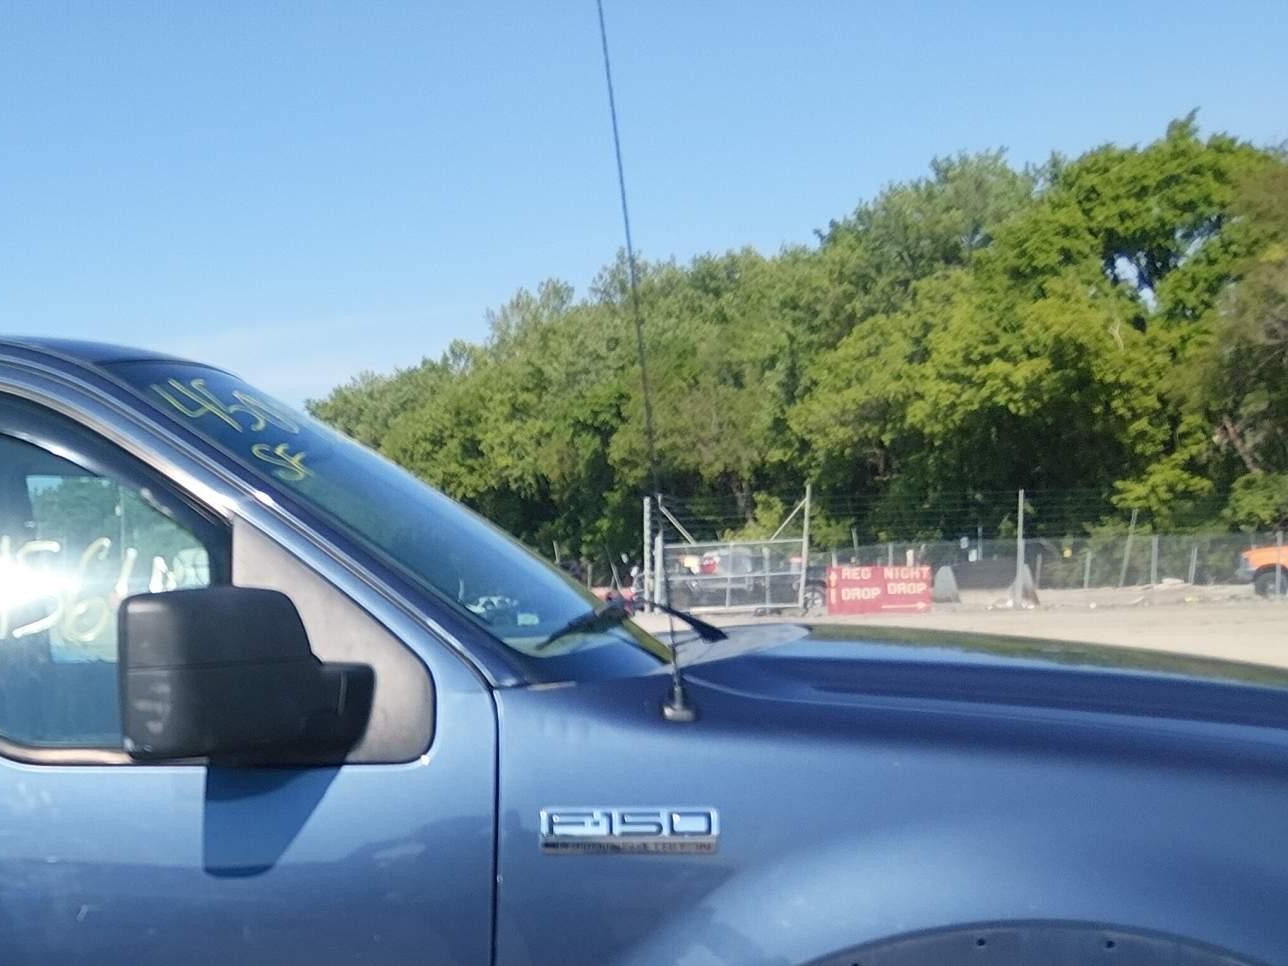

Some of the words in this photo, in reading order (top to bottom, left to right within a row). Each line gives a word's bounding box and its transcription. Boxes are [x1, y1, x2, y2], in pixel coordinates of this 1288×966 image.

[841, 567, 873, 580] REG
[883, 566, 931, 580] NIGHT
[841, 587, 881, 601] DROP
[887, 582, 928, 595] DROP
